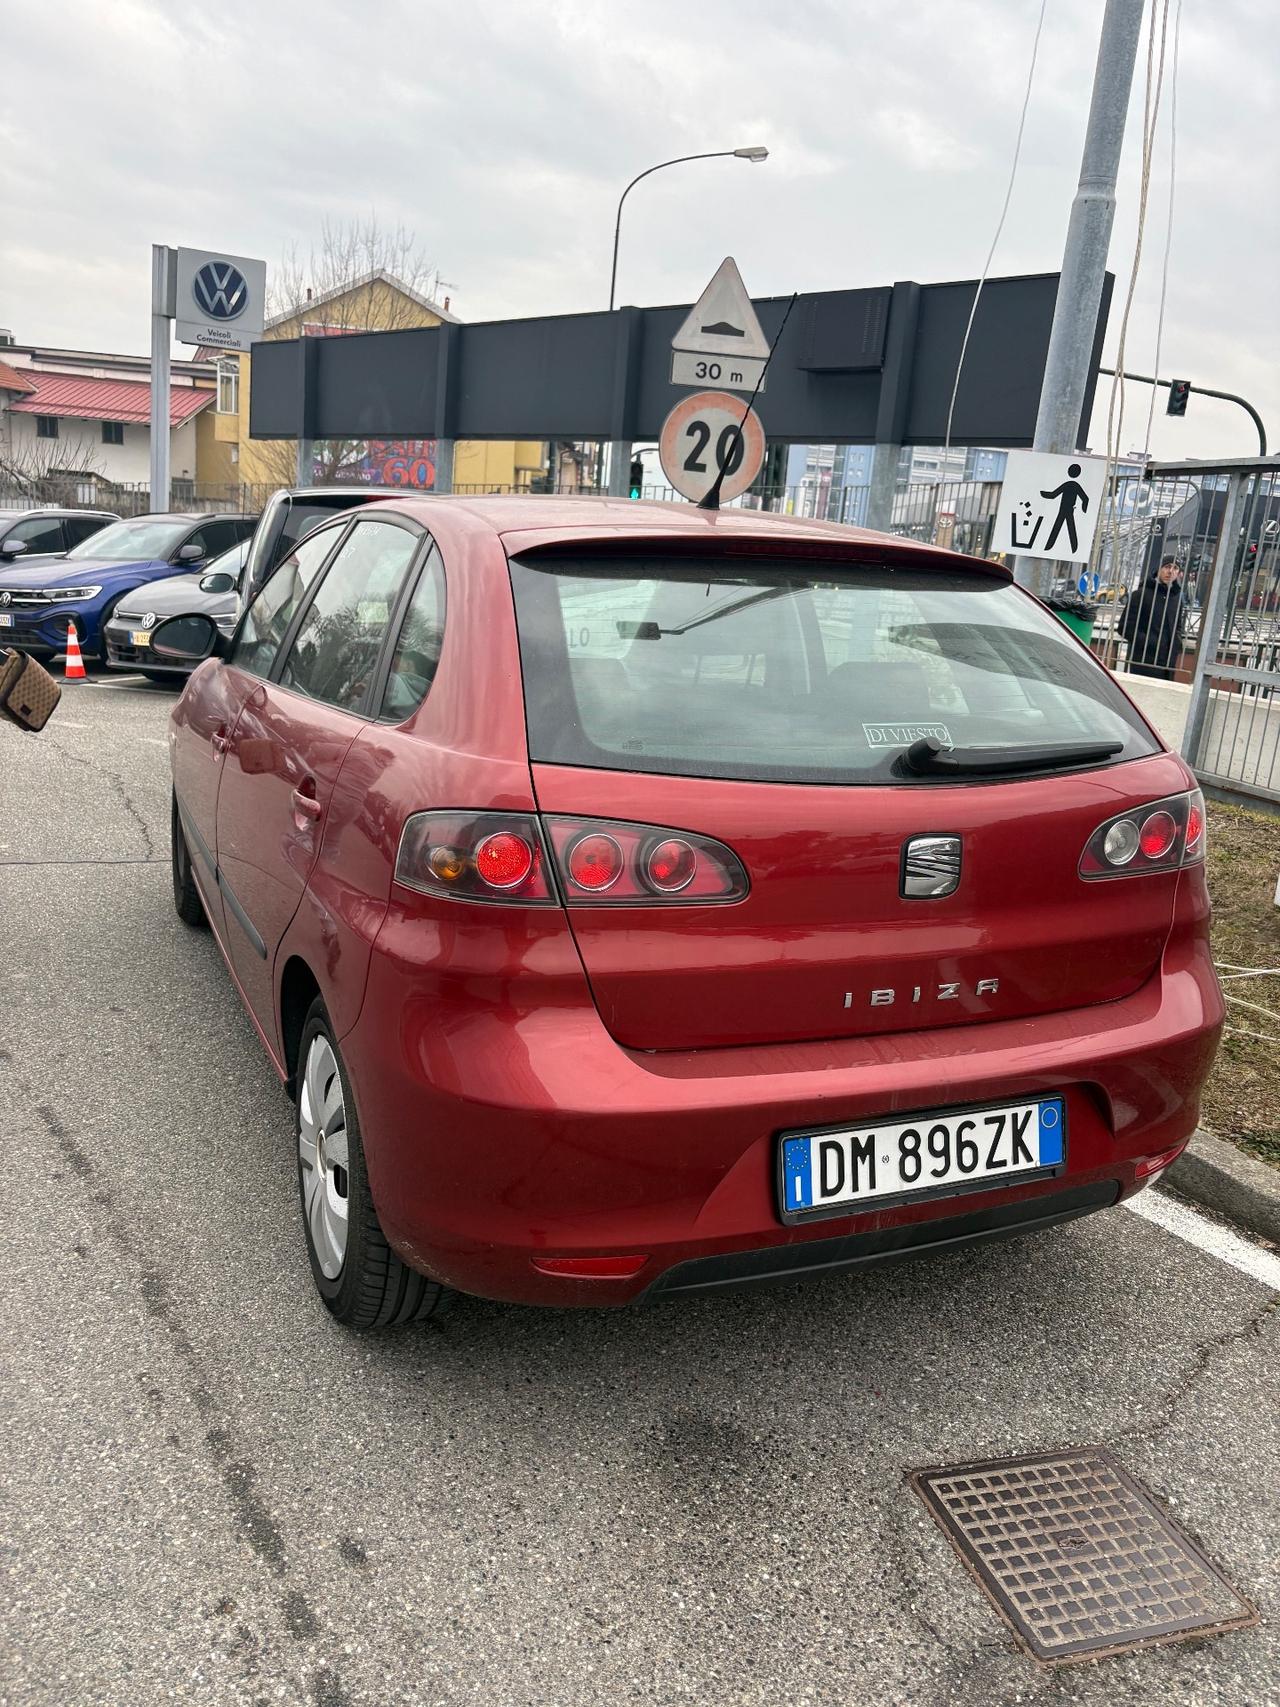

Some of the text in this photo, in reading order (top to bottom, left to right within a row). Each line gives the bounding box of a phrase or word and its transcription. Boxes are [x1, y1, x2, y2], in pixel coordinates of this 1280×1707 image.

[196, 334, 241, 348] Commerciali
[207, 328, 232, 339] Veicoli
[695, 361, 743, 383] 30 m
[683, 420, 745, 476] 20
[382, 457, 436, 489] 60
[867, 727, 947, 742] DI VIESTO
[843, 978, 999, 1009] IBIZA
[819, 1134, 877, 1198] DM
[898, 1109, 1034, 1184] 896ZK
